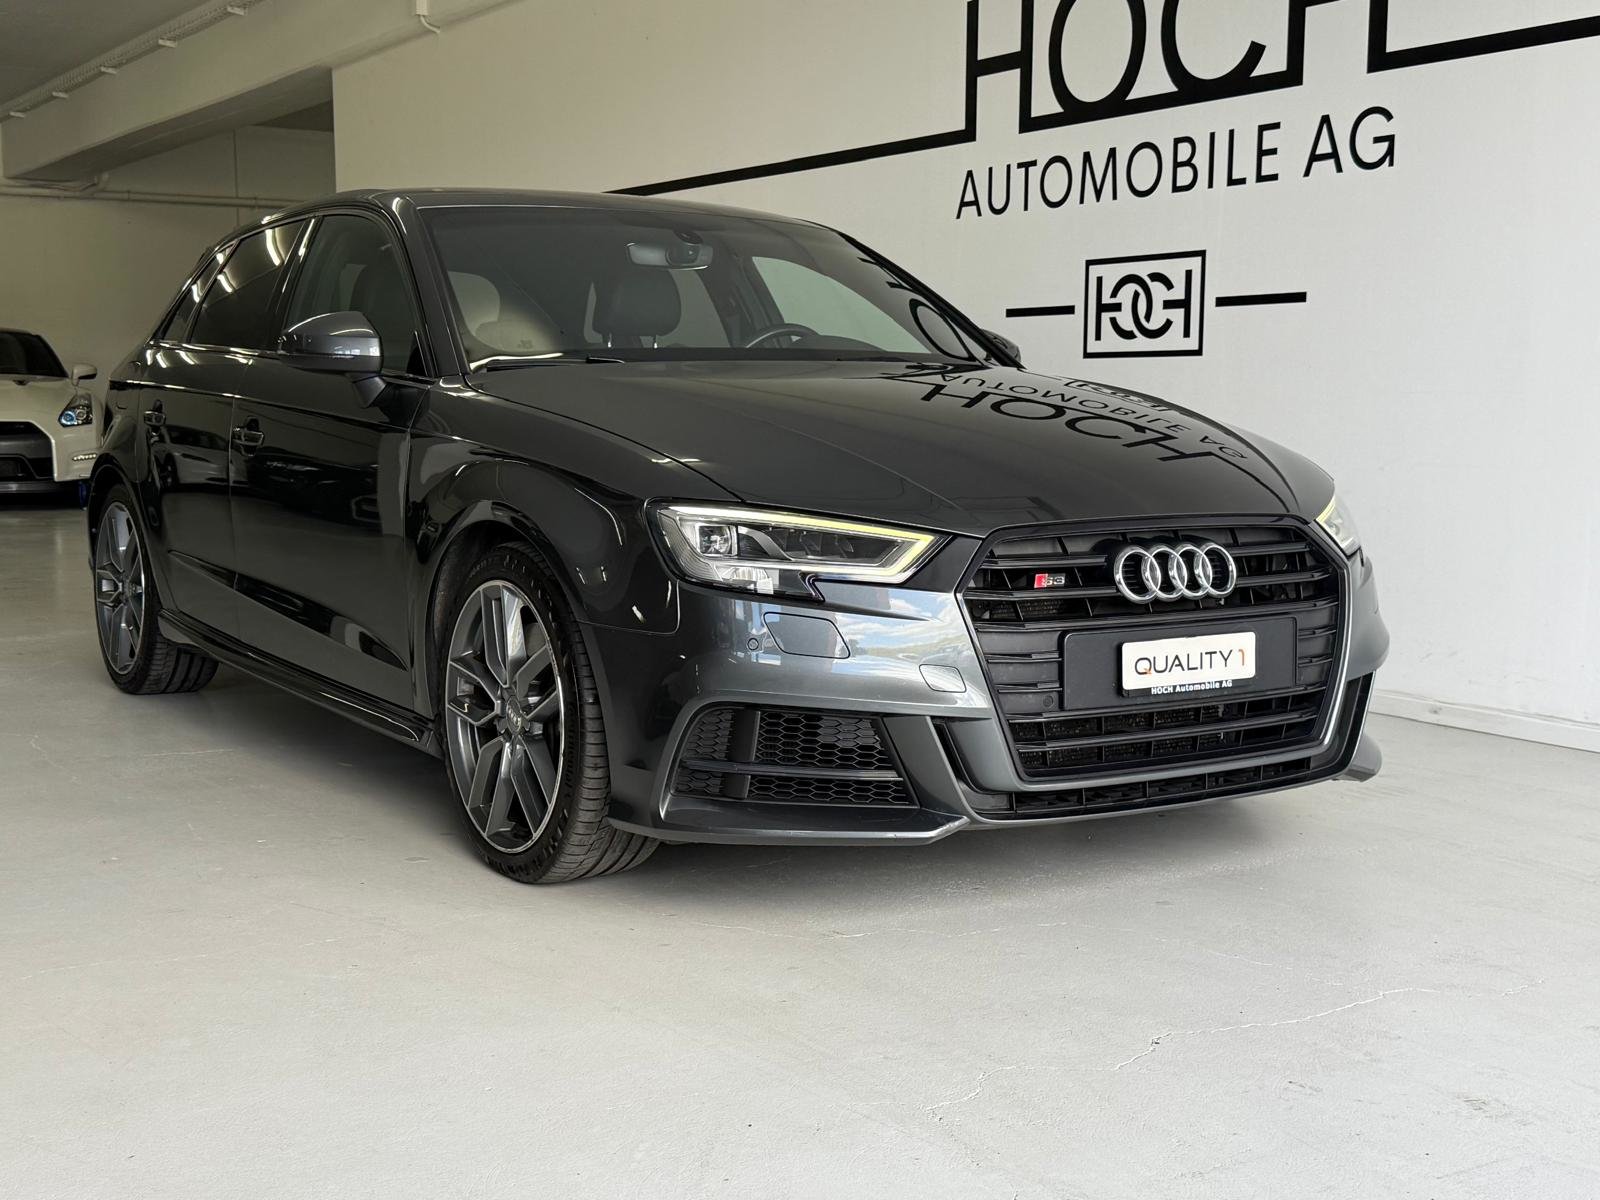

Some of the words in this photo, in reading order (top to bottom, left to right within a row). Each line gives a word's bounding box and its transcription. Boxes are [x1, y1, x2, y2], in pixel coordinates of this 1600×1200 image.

[955, 121, 1281, 220] AUTOMOBILE
[1302, 106, 1396, 178] AG
[1040, 575, 1065, 587] S3
[1134, 649, 1233, 676] QUALITY
[1238, 648, 1245, 667] 1
[1151, 685, 1174, 695] HOCH
[1175, 681, 1220, 693] Automobile
[1221, 679, 1233, 688] AG
